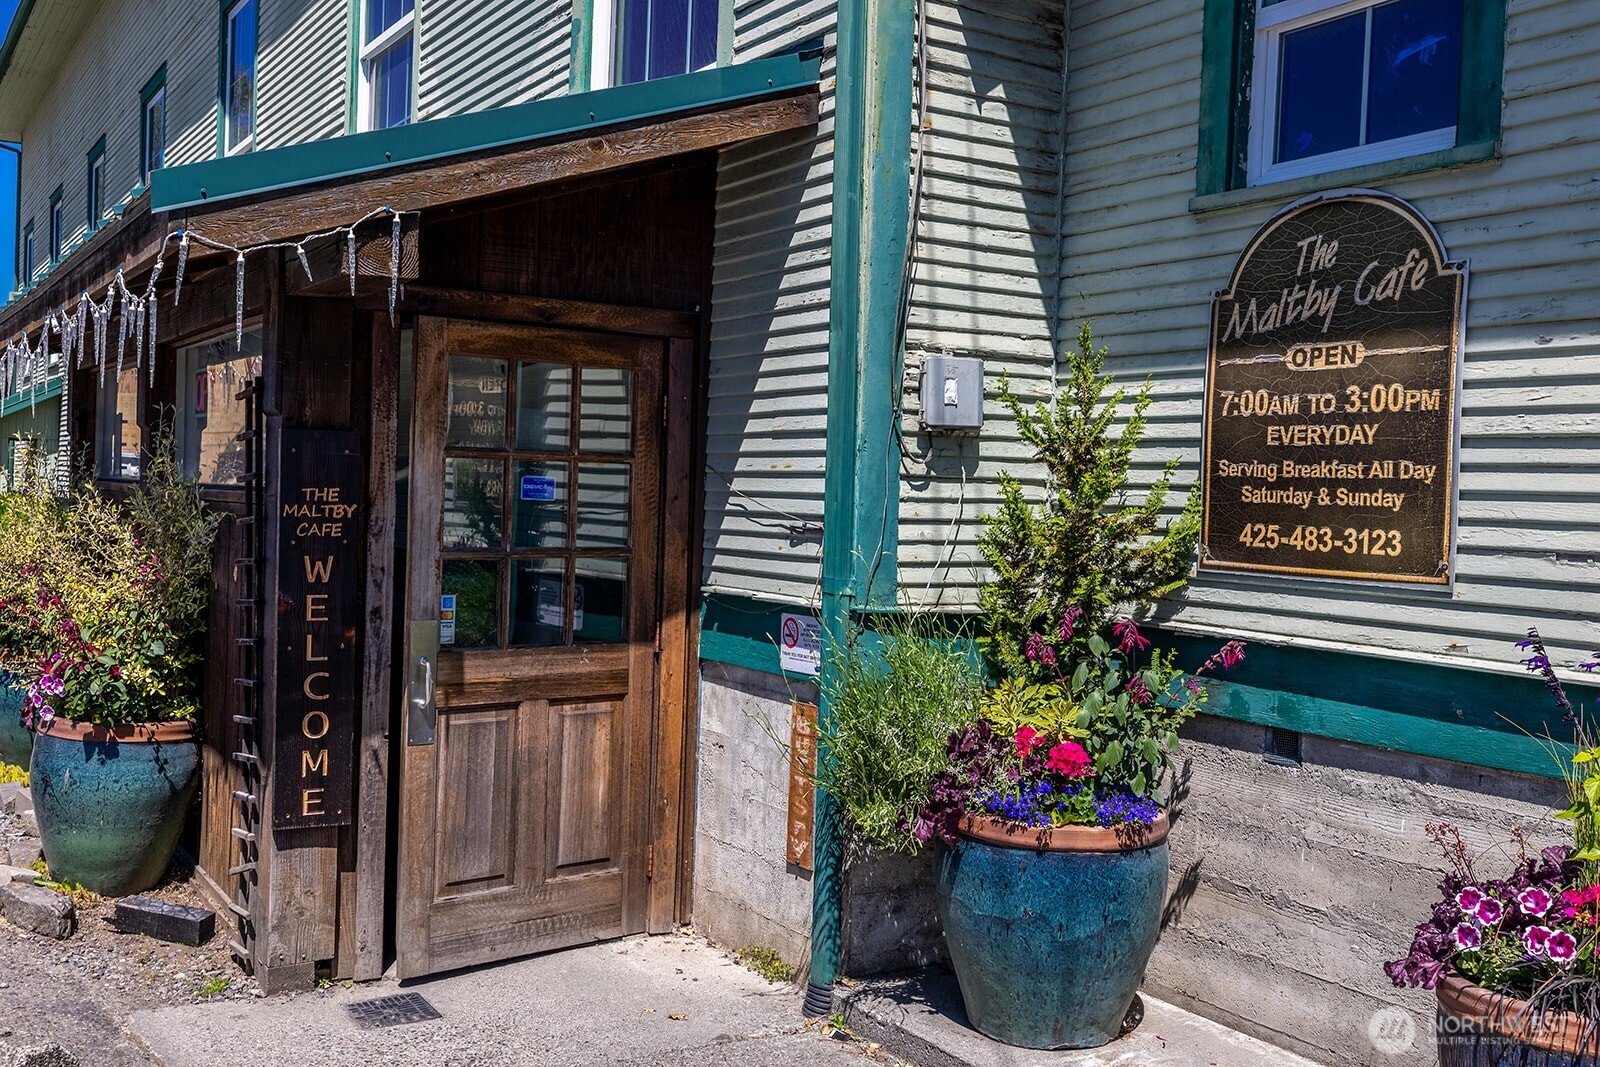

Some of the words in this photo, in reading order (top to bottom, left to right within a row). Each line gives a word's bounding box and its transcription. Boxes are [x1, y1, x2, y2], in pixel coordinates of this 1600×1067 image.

[1296, 235, 1339, 276] The
[1221, 279, 1342, 343] Maltby
[1354, 248, 1429, 306] Cafe
[1291, 345, 1358, 368] OPEN
[1219, 389, 1300, 417] 7:00AM
[1308, 393, 1336, 414] TO
[1345, 383, 1442, 413] 3:00PM
[1266, 424, 1380, 446] EVERYDAY
[1218, 460, 1278, 482] Serving
[1283, 460, 1364, 479] Breakfast
[1369, 460, 1394, 479] All
[1400, 460, 1436, 484] Day
[302, 487, 340, 502] THE
[1241, 486, 1313, 510] Saturday
[1317, 487, 1331, 505] &
[1336, 487, 1405, 511] Sunday
[283, 504, 358, 519] MALTBY
[296, 522, 343, 537] CAFE
[1239, 523, 1402, 557] 425-483-3123
[302, 555, 334, 816] WELCOME
